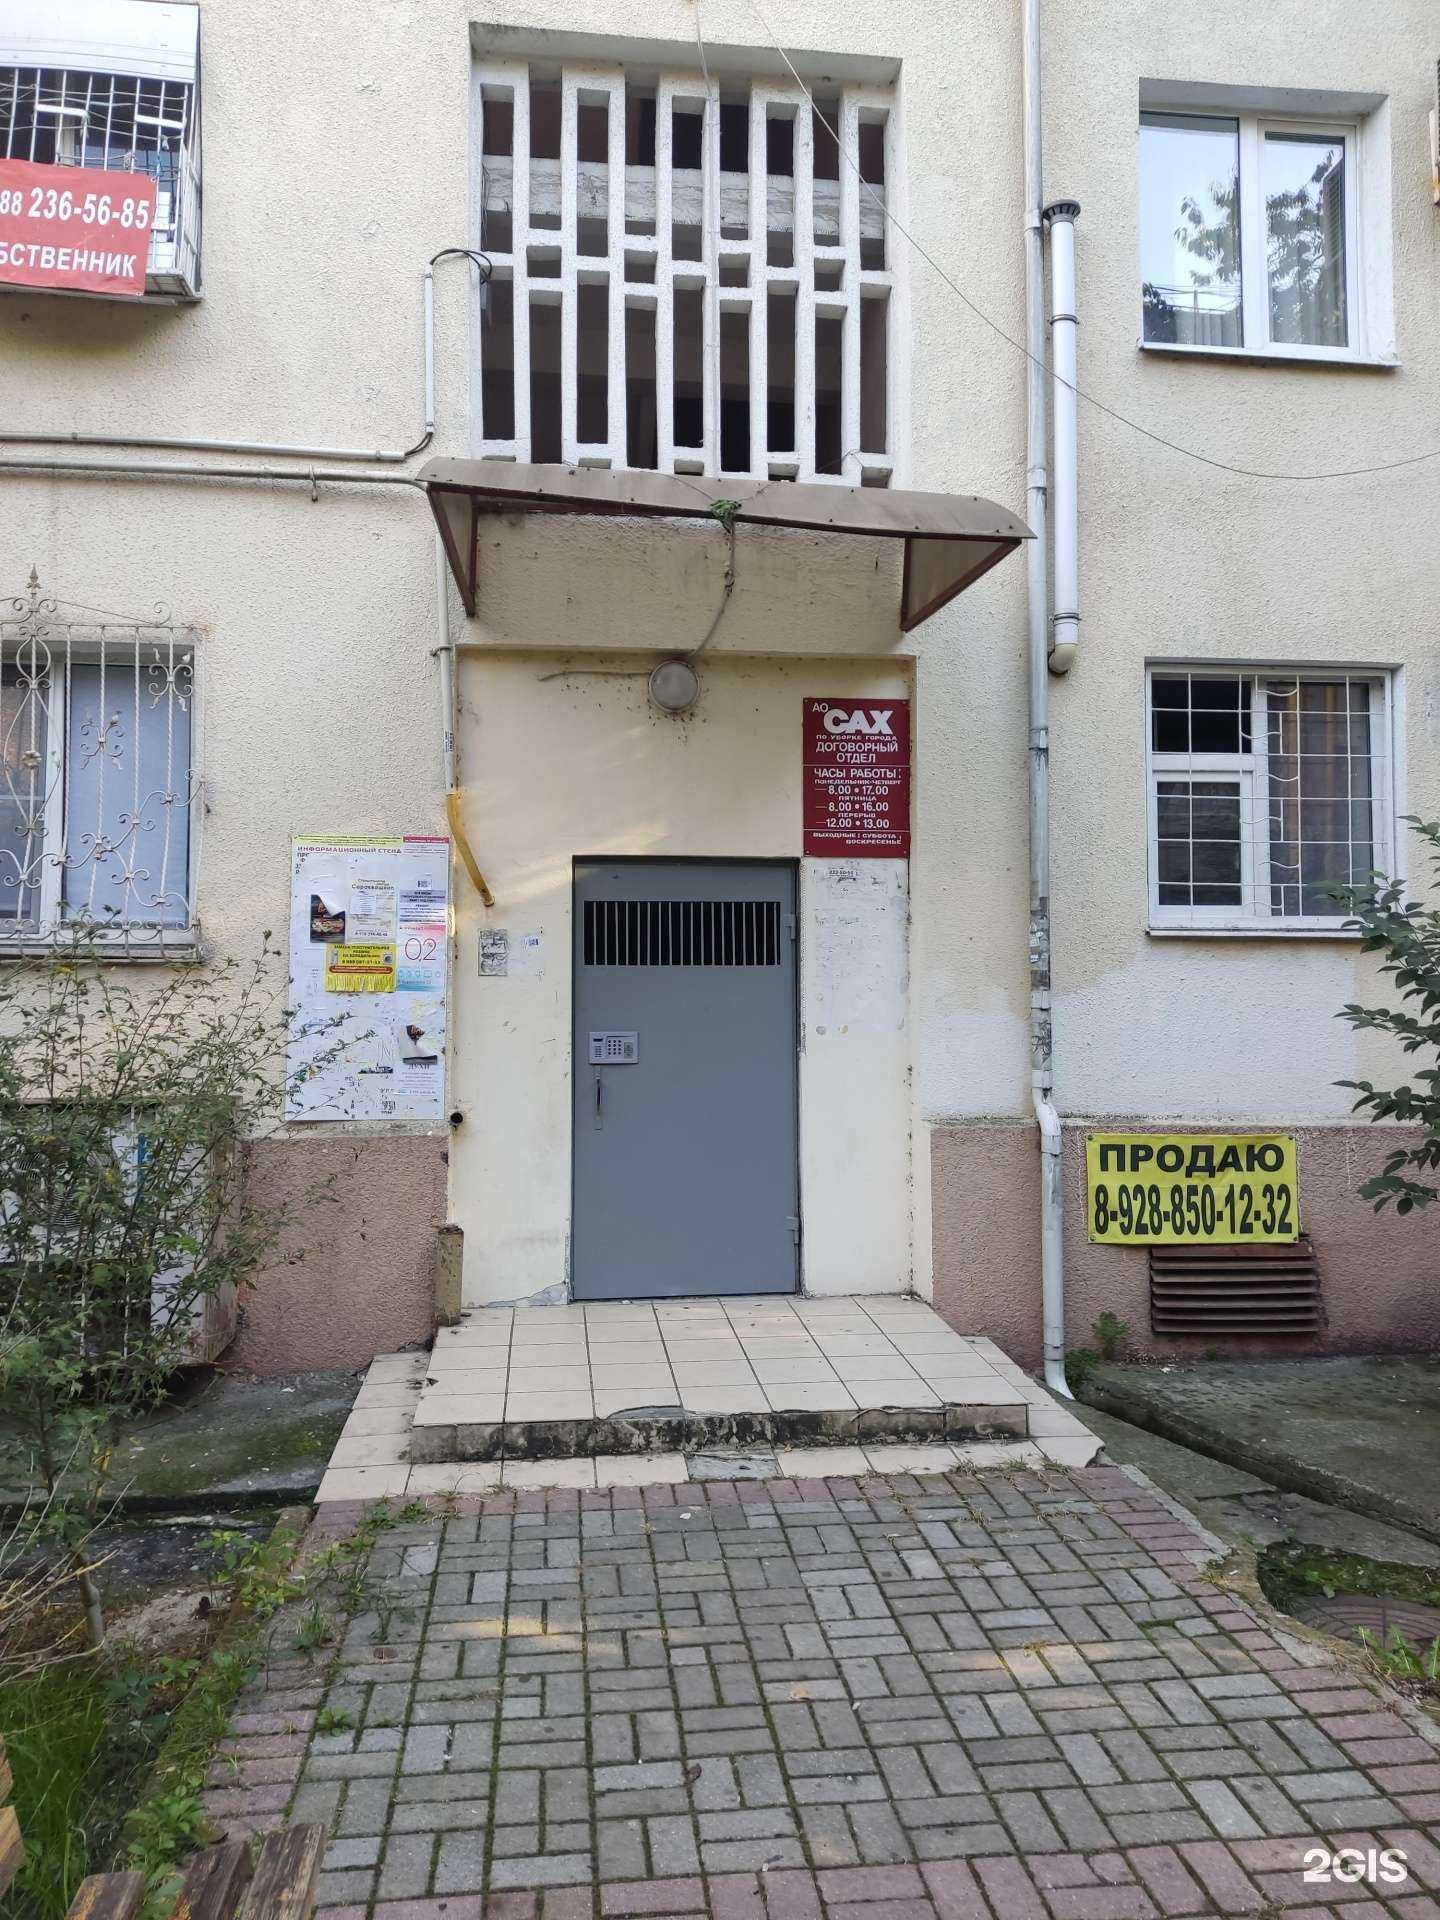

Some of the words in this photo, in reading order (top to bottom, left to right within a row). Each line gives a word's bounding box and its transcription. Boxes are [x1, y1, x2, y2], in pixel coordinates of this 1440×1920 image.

[28, 186, 150, 230] 236-56-85
[812, 703, 829, 713] АО
[823, 708, 894, 735] САХ
[815, 741, 899, 753] ДОГОВОРНЫЙ
[836, 752, 876, 764] ОТДЕЛ
[814, 768, 846, 778] ЧАСЫ
[1099, 1143, 1285, 1179] ПРОДАЮ
[1094, 1183, 1293, 1236] 8-928-850-12-32
